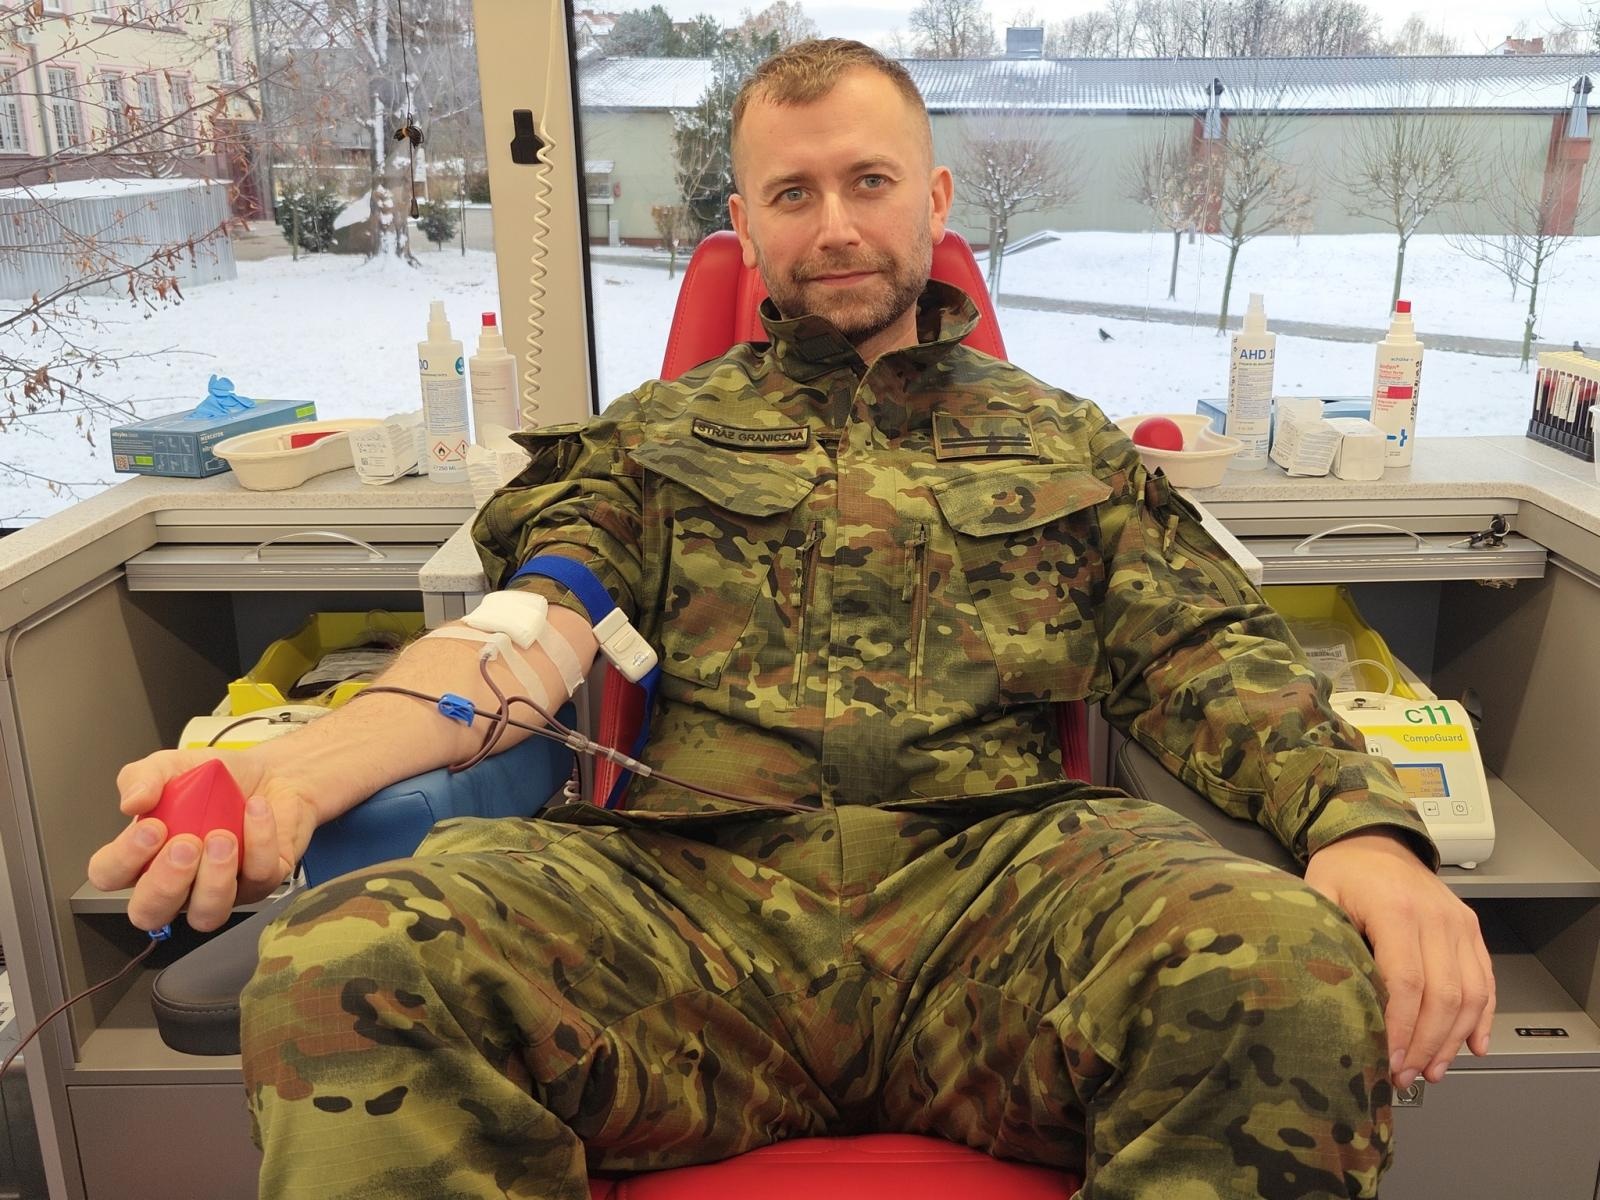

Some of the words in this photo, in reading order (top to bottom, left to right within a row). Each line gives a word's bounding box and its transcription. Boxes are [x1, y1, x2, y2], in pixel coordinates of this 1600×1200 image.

[1240, 349, 1267, 360] AHD
[738, 431, 804, 442] GRANICZNA
[1403, 734, 1463, 742] CompoGuard
